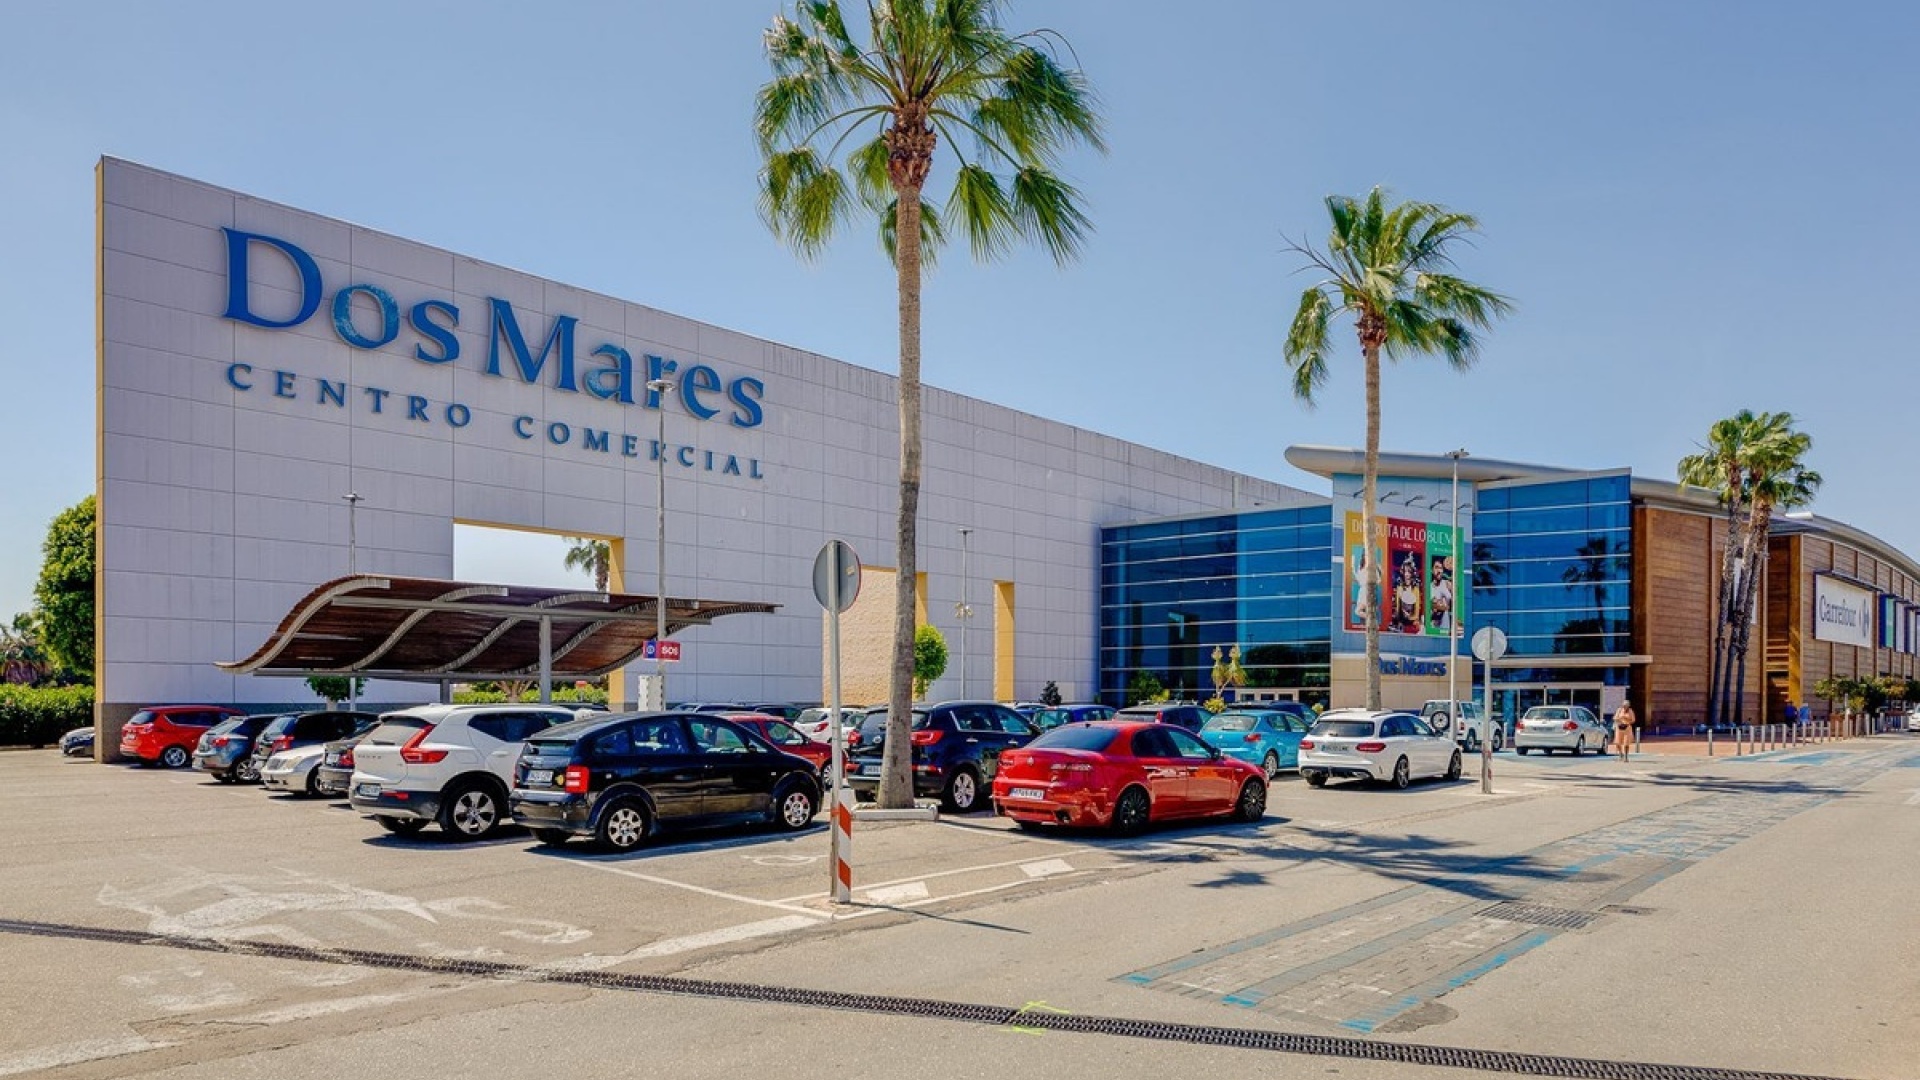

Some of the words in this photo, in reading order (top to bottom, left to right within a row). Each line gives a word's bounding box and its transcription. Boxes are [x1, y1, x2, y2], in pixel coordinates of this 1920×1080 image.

[220, 226, 461, 365] Dos
[483, 295, 765, 429] Mares
[226, 362, 472, 428] CENTRO
[513, 415, 764, 480] COMERCIAL
[1820, 594, 1856, 627] Carrefour
[662, 645, 678, 656] SOS
